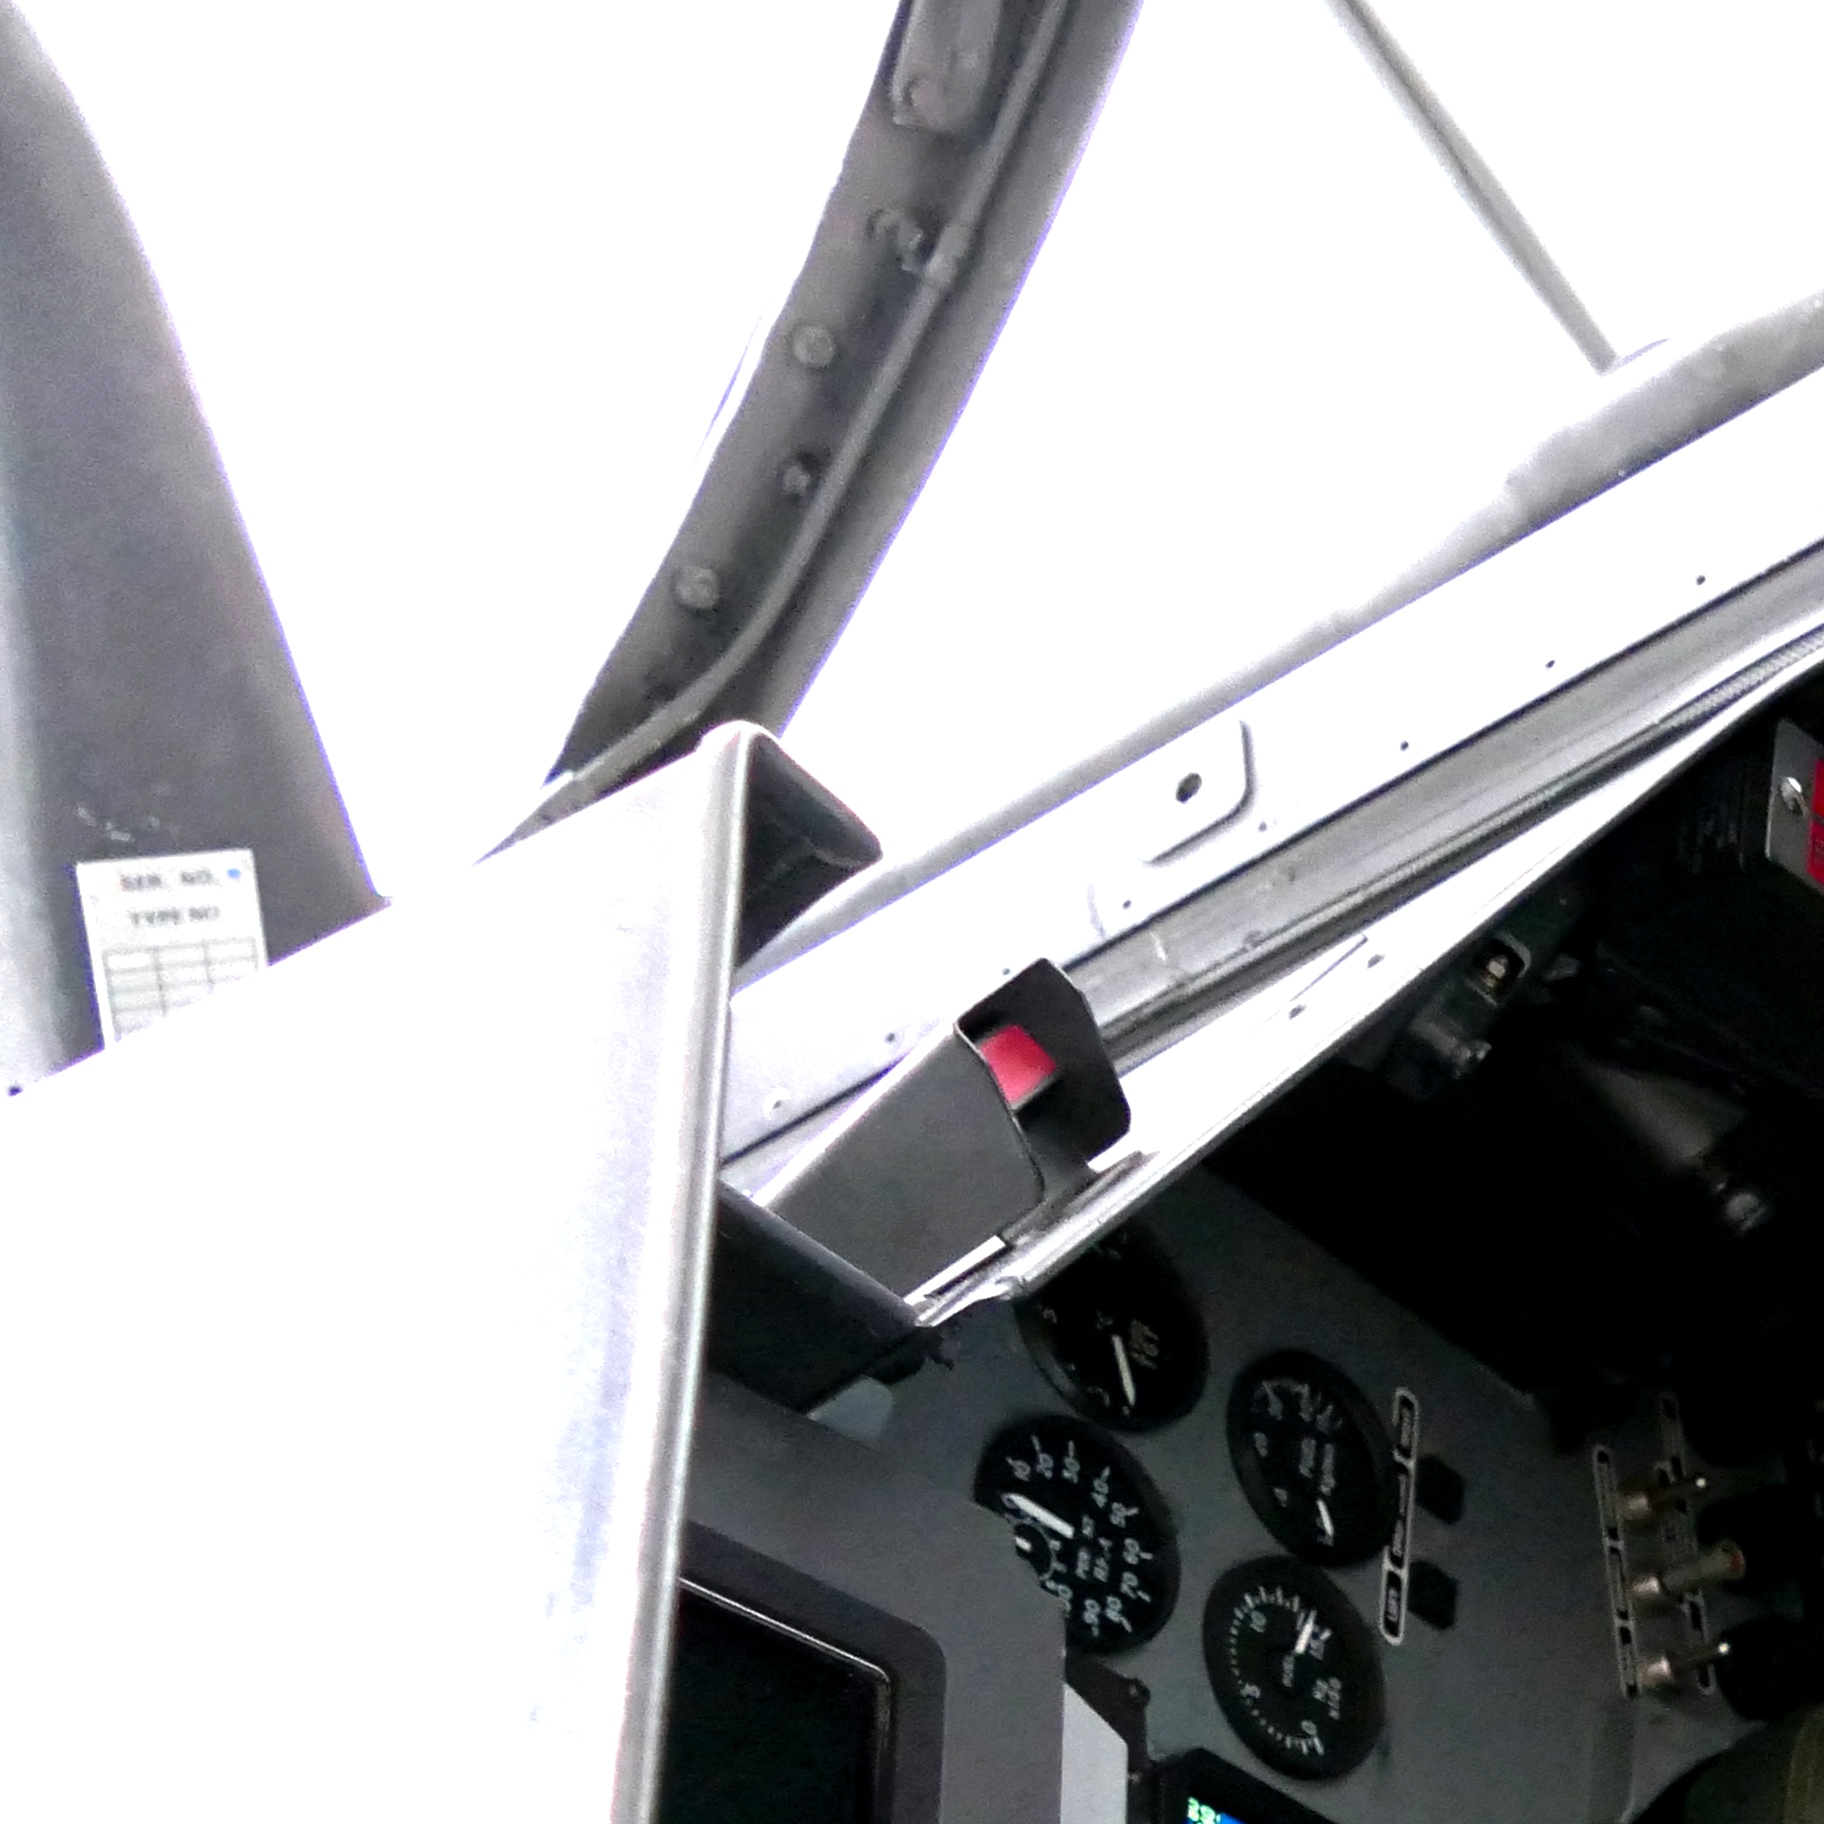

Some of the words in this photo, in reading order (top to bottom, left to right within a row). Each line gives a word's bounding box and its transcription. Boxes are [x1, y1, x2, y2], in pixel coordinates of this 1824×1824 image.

[1035, 1451, 1056, 1478] 20
[1059, 1456, 1082, 1483] 30
[1088, 1478, 1110, 1508] 40
[1119, 1536, 1142, 1565] 60
[1117, 1570, 1141, 1599] 70
